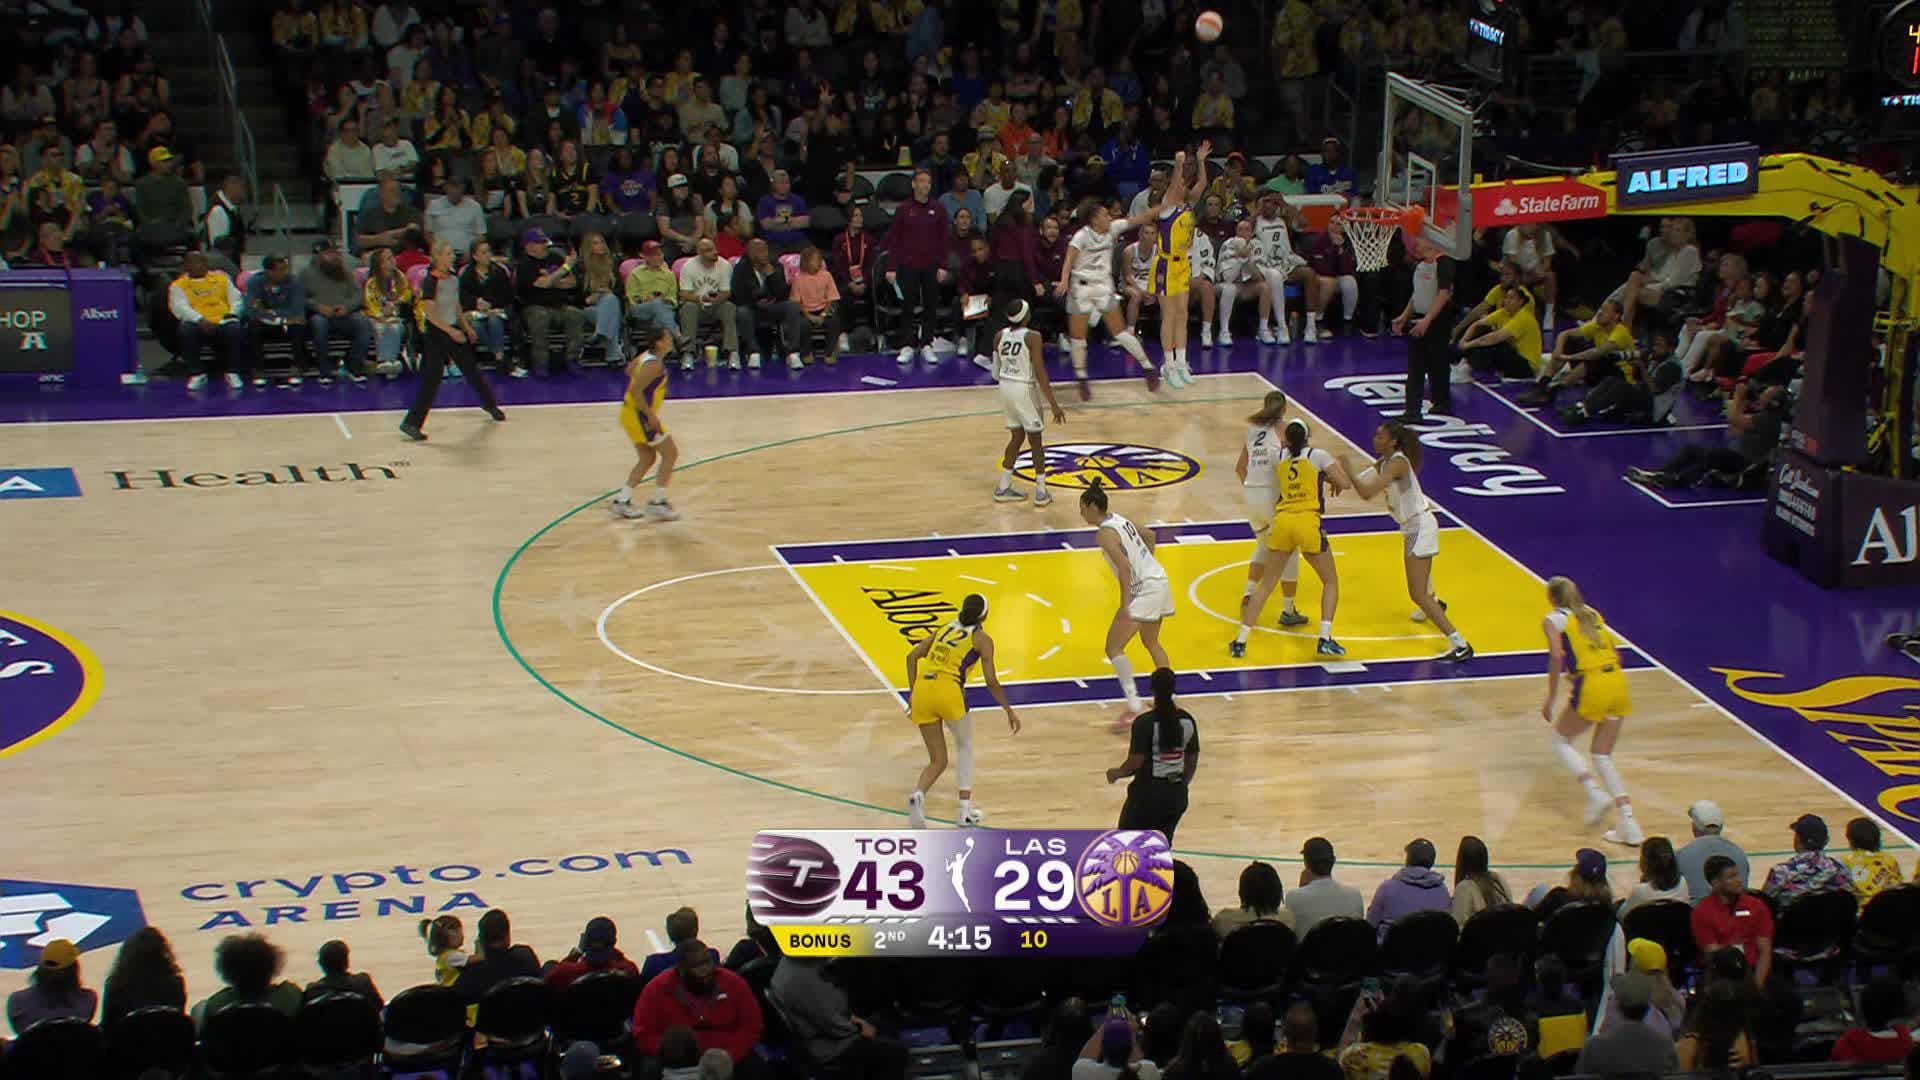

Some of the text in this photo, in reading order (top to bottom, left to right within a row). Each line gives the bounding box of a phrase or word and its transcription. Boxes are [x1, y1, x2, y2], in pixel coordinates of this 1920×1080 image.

[1627, 161, 1749, 194] ALFRED
[81, 307, 120, 321] Albert
[1001, 341, 1023, 357] 20
[1254, 430, 1267, 448] 2
[104, 462, 401, 490] Health
[1287, 461, 1299, 481] 5
[937, 626, 969, 648] 12
[181, 846, 693, 902] crypto.com
[198, 892, 490, 931] ARENA
